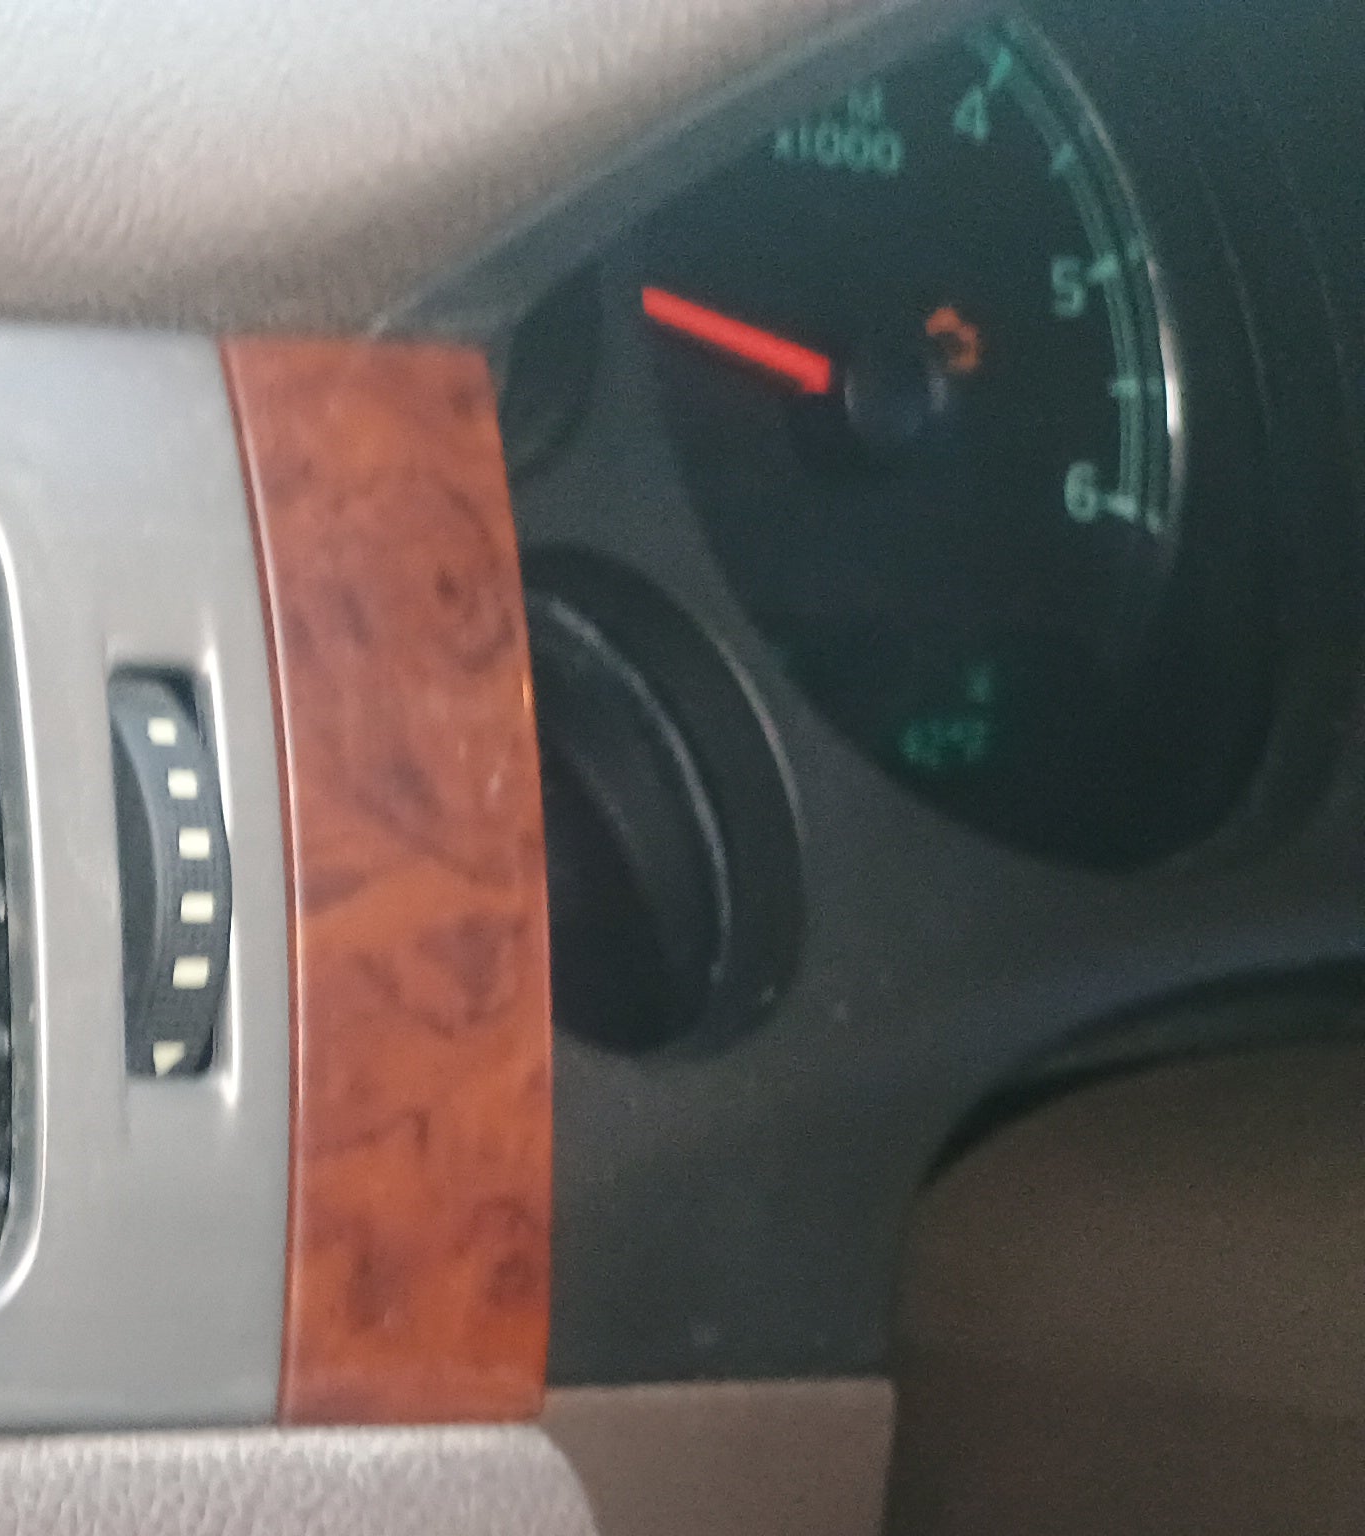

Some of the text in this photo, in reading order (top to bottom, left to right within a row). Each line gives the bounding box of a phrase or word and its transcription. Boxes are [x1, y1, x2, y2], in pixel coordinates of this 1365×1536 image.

[953, 86, 989, 140] 4
[1051, 256, 1085, 318] 5
[1064, 460, 1097, 522] 6
